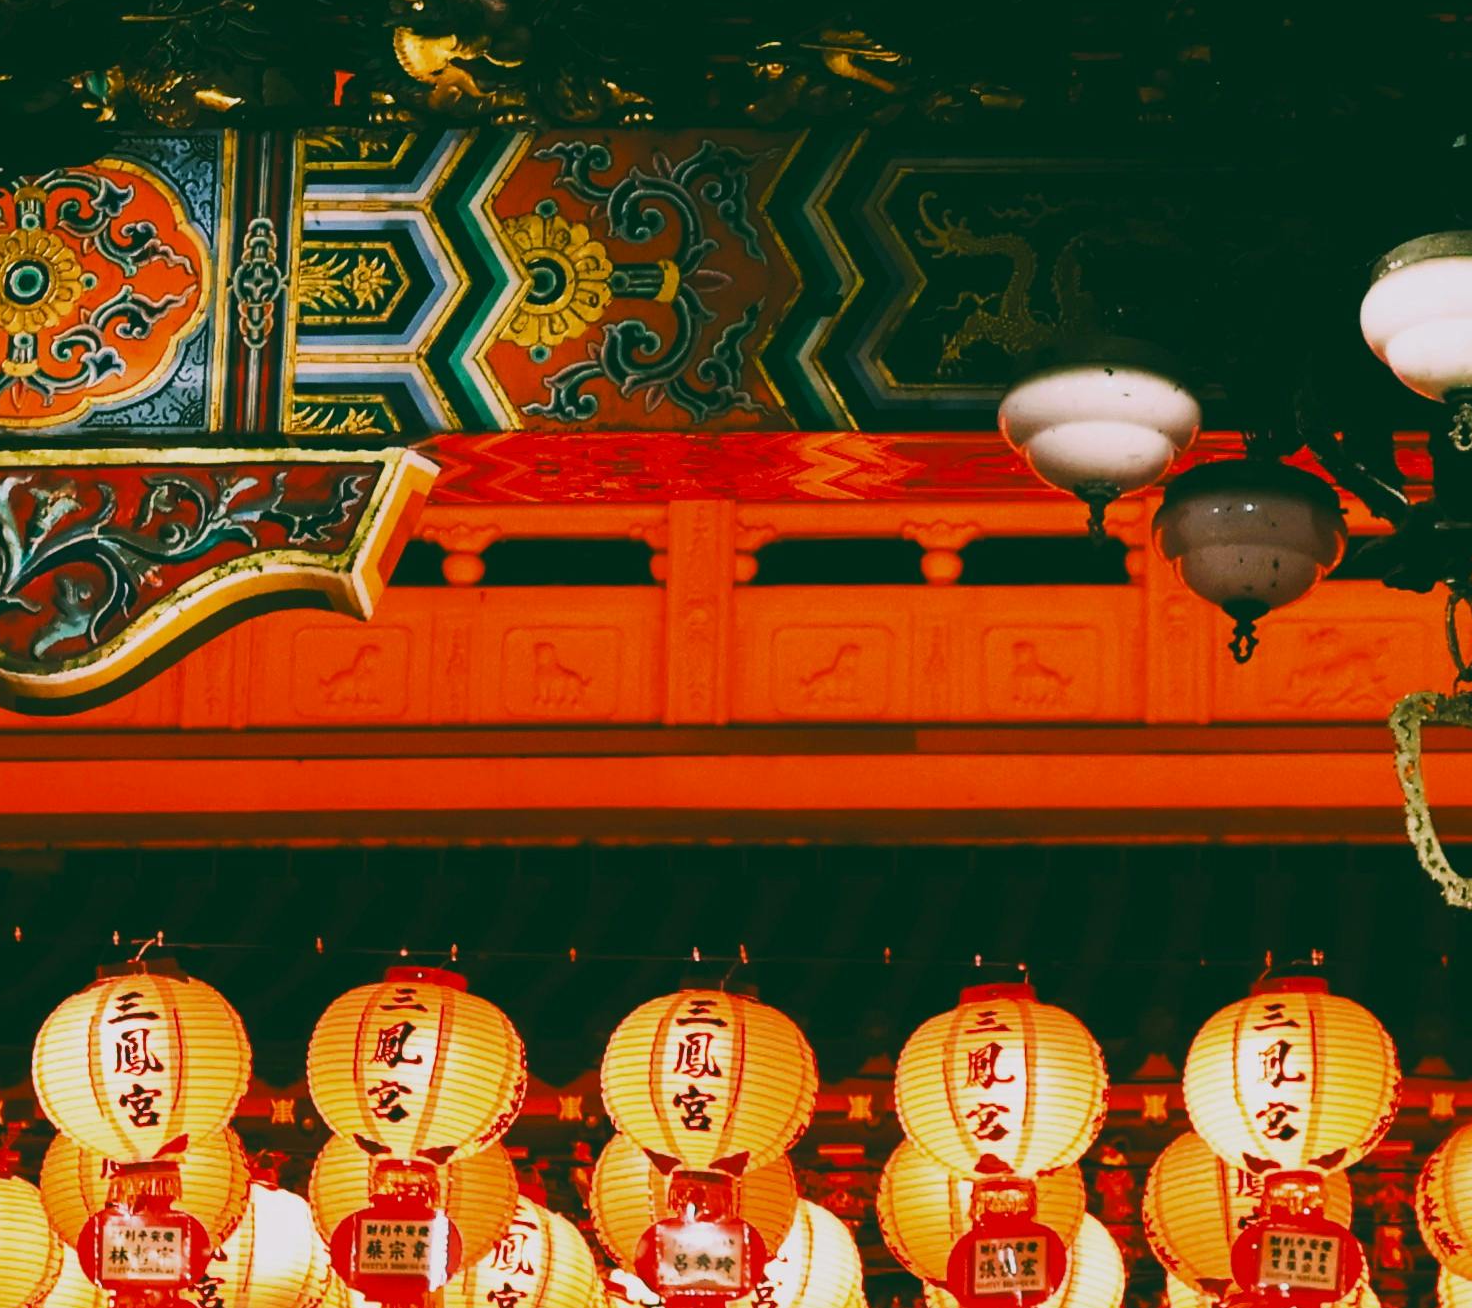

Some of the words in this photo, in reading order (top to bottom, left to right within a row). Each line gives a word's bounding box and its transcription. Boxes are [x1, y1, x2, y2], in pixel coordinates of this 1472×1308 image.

[107, 992, 164, 1127] 三鳳宮
[368, 988, 425, 1122] 三鳳宮
[672, 1000, 727, 1131] 三鳳宮
[965, 1011, 1014, 1139] 三鳳宮
[1253, 1003, 1305, 1139] 三鳳宮
